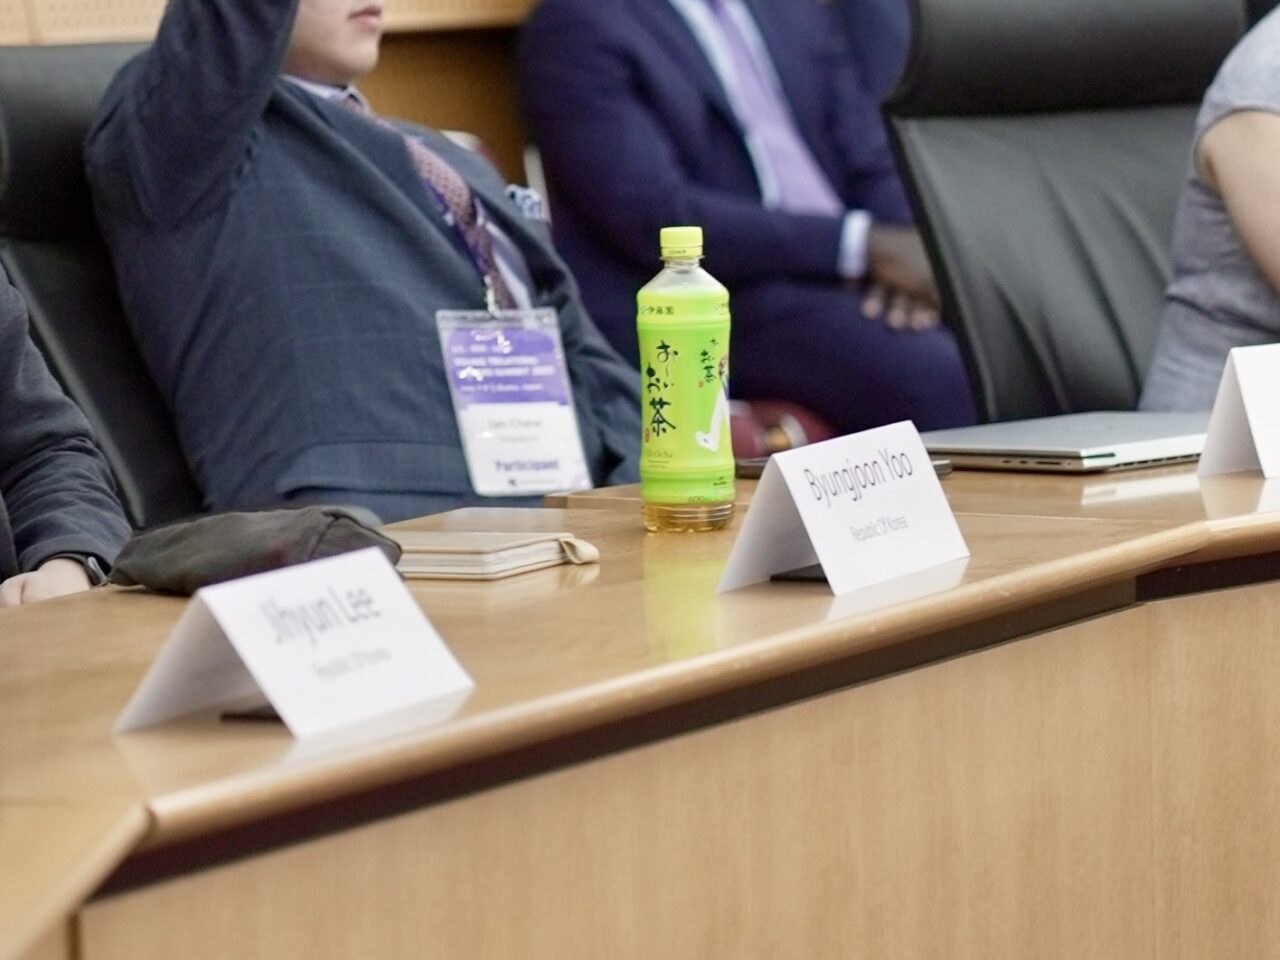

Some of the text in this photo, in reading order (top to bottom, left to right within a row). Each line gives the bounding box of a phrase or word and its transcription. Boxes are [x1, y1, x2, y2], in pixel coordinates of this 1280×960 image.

[804, 448, 913, 509] Byungjoon Yoo
[327, 584, 382, 623] Lee
